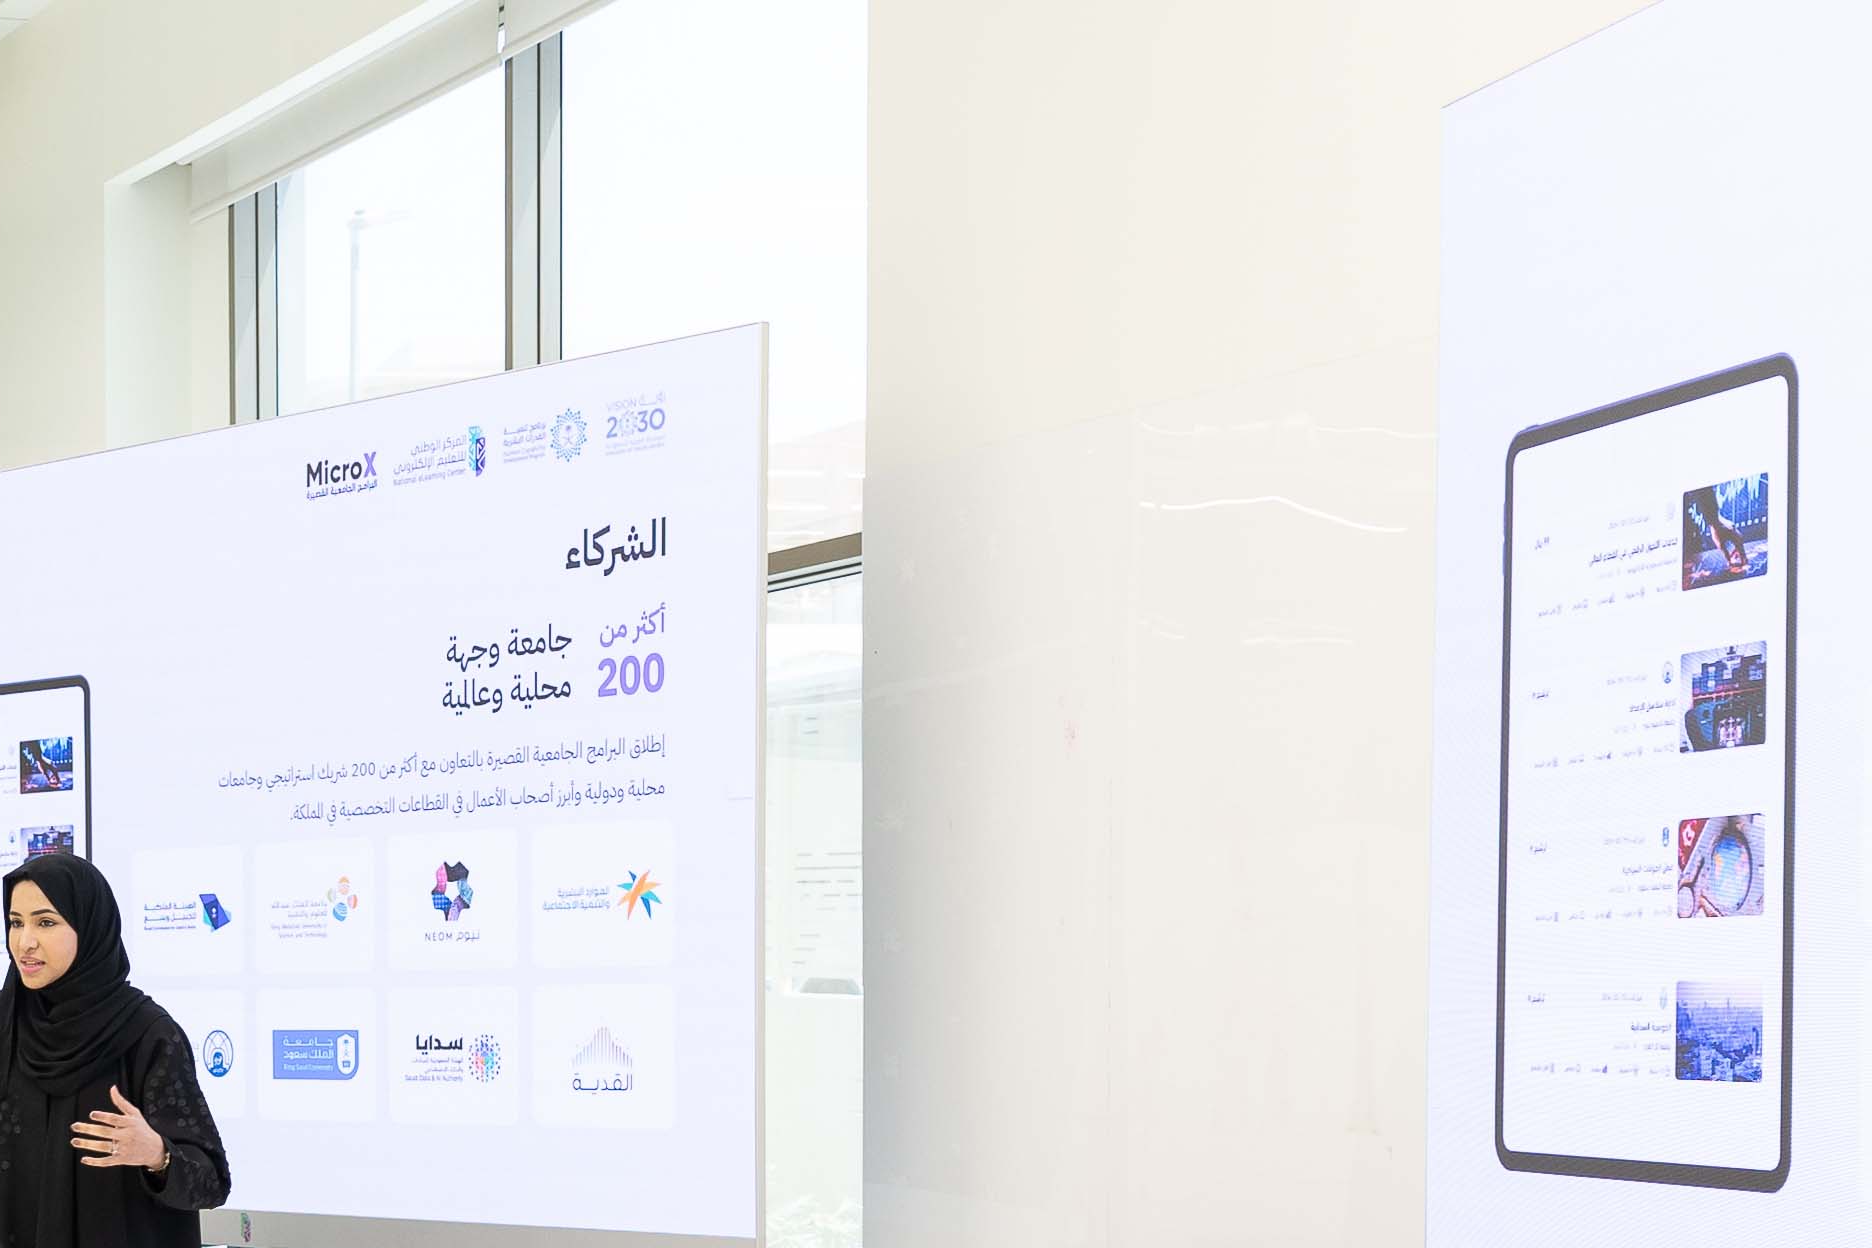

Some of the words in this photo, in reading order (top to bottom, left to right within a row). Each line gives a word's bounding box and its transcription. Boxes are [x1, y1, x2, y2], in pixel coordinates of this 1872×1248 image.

[306, 451, 377, 488] MicroX
[565, 516, 667, 577] الشركاء
[631, 601, 667, 644] أكثر
[507, 623, 573, 660] جامعة
[599, 624, 628, 648] من
[446, 635, 500, 673] وجهة
[597, 652, 666, 698] 200
[442, 677, 504, 716] وعالمية
[510, 671, 572, 710] محلية
[486, 745, 530, 771] القصيرة
[532, 740, 583, 767] الجامعية
[586, 737, 626, 764] البرامج
[629, 733, 666, 759] إطلاق
[318, 760, 348, 783] شريك
[351, 762, 376, 777] 200
[379, 763, 397, 780] من
[398, 752, 418, 778] أكثر
[420, 759, 436, 778] مع
[439, 750, 484, 775] بالتعاون
[218, 770, 263, 790] وجامعات
[555, 779, 582, 807] وأبرز
[585, 781, 625, 804] ودولية
[627, 777, 666, 801] محلية
[339, 796, 395, 821] التخصصية
[398, 792, 449, 813] القطاعات
[452, 790, 463, 818] في
[466, 786, 506, 813] الأعمال
[510, 781, 554, 810] أصحاب
[326, 803, 337, 826] في
[424, 932, 453, 942] NEOM
[282, 1035, 335, 1047] جامعة
[415, 1034, 463, 1055] سدايا
